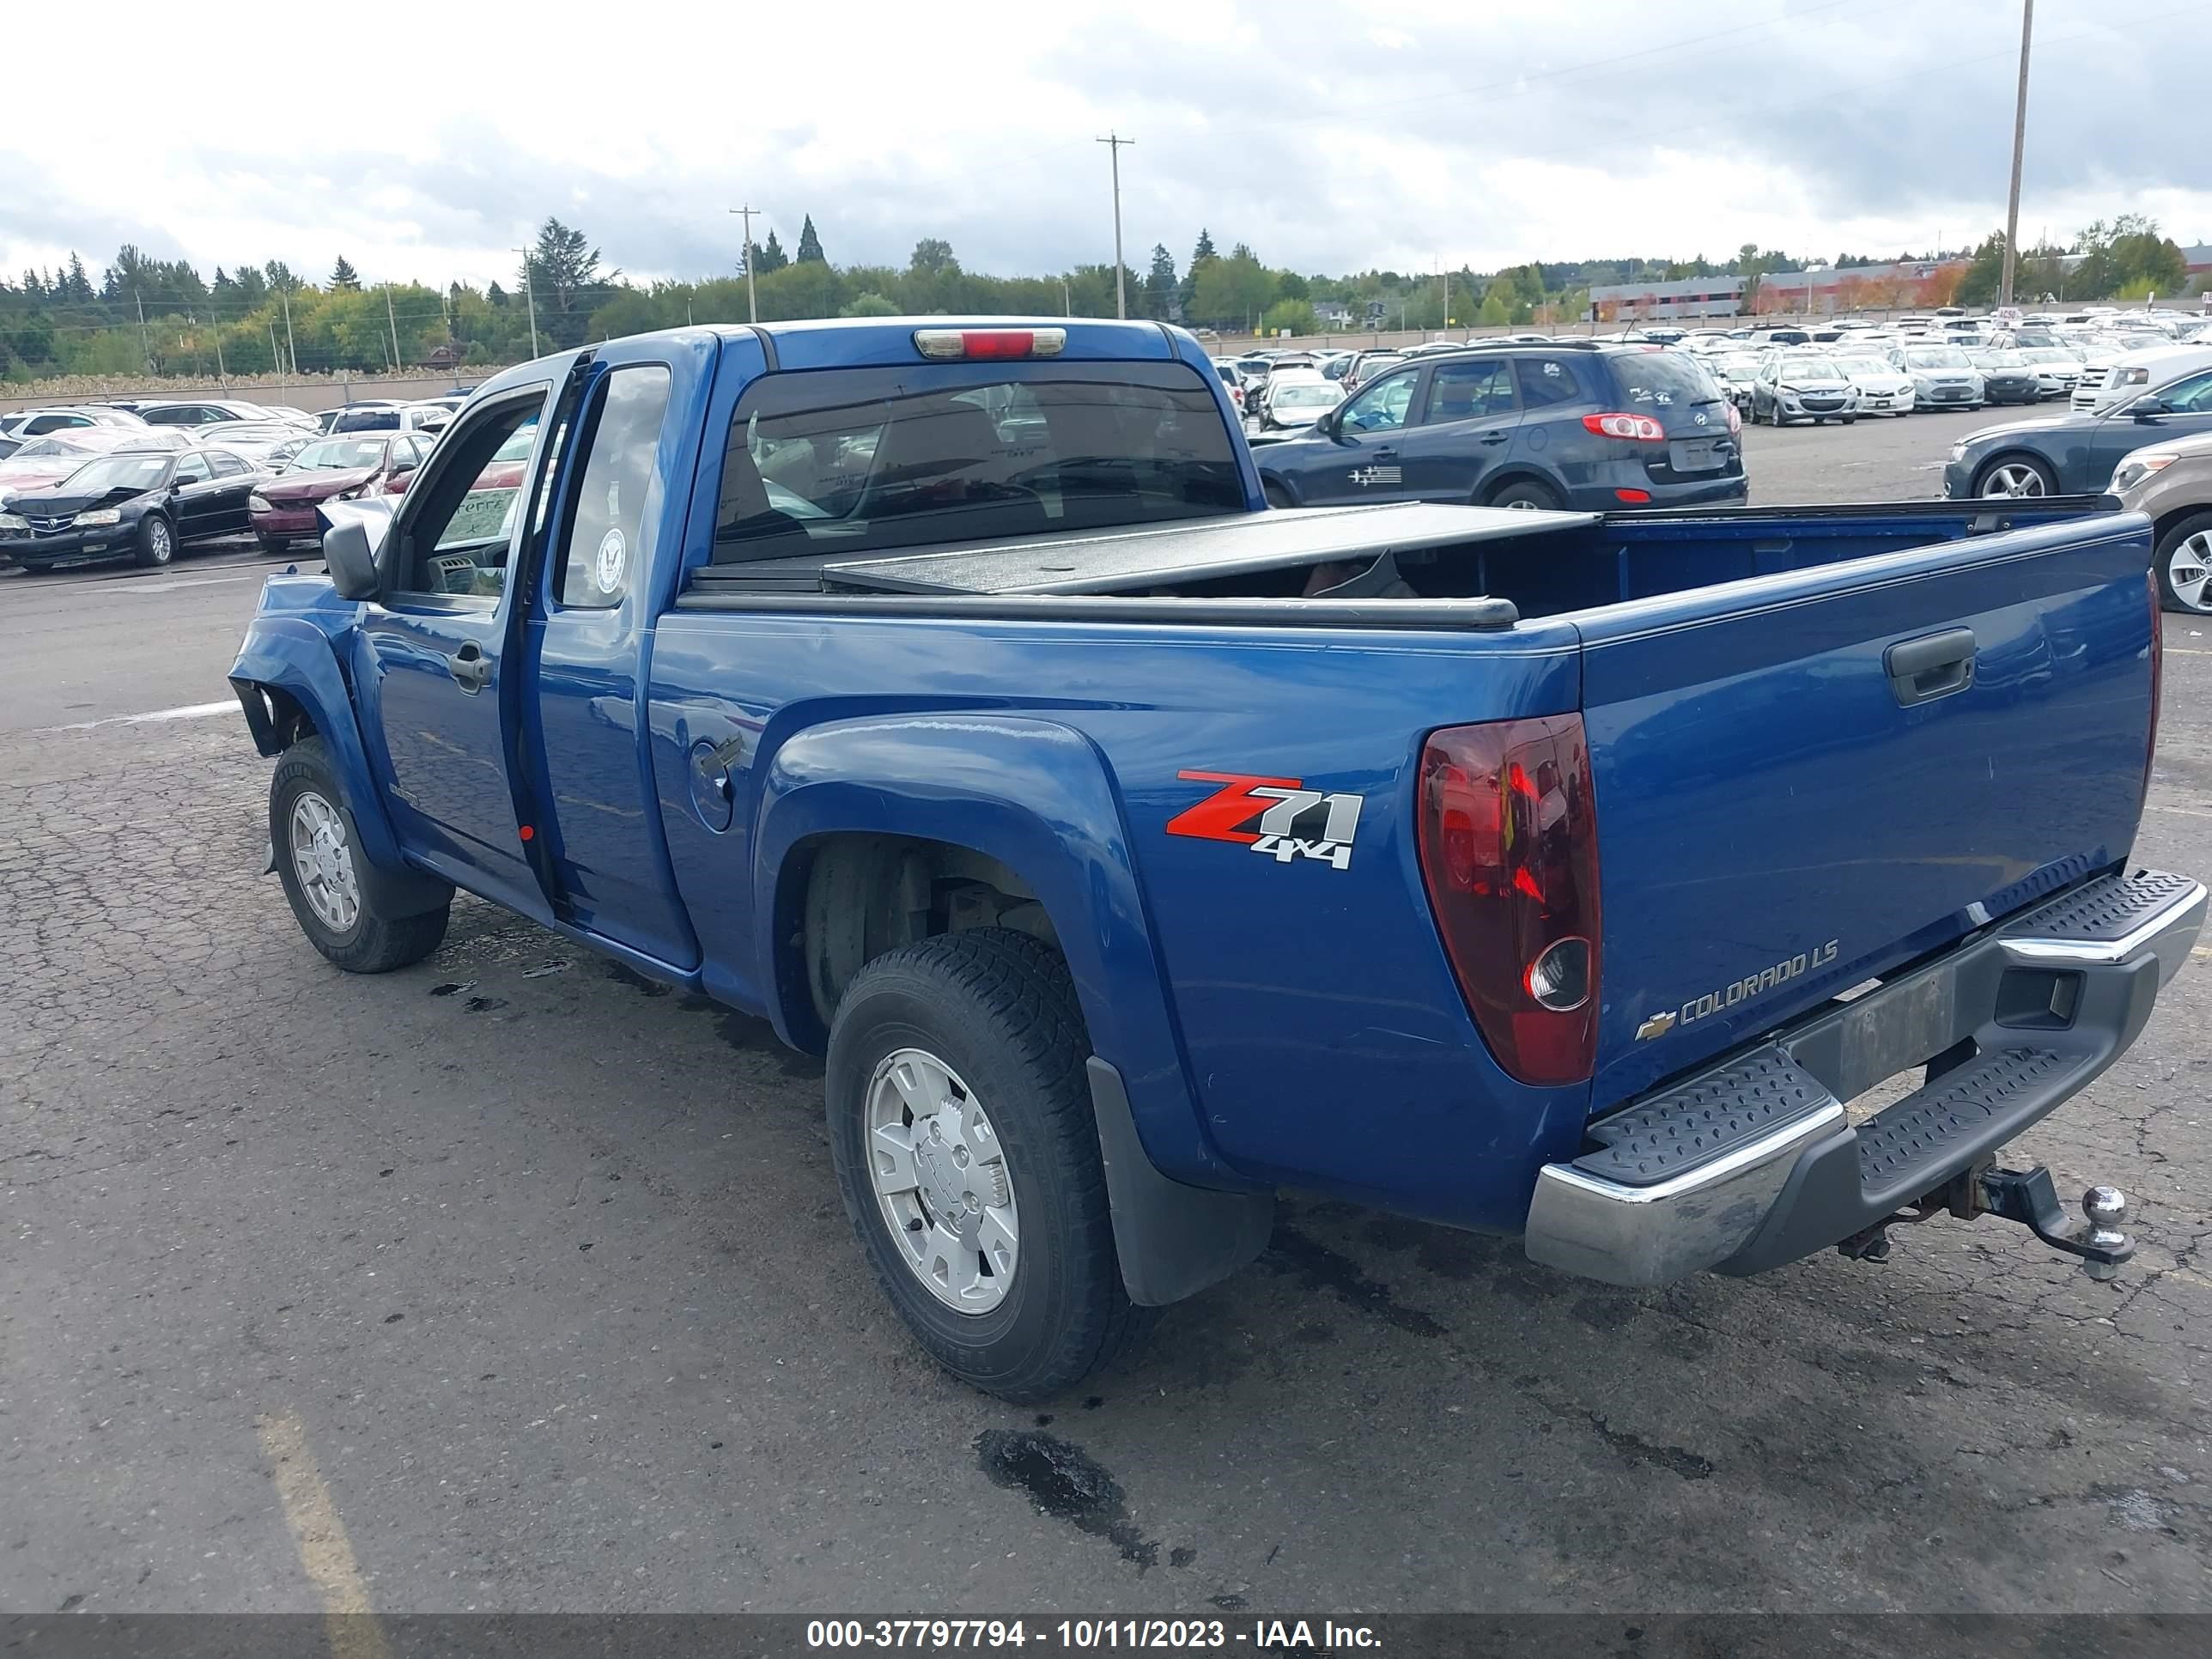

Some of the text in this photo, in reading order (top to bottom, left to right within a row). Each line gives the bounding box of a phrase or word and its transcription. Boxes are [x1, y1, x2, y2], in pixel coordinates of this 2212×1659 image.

[1166, 769, 1364, 844] Z71
[1680, 939, 1838, 1025] COLORADO LS
